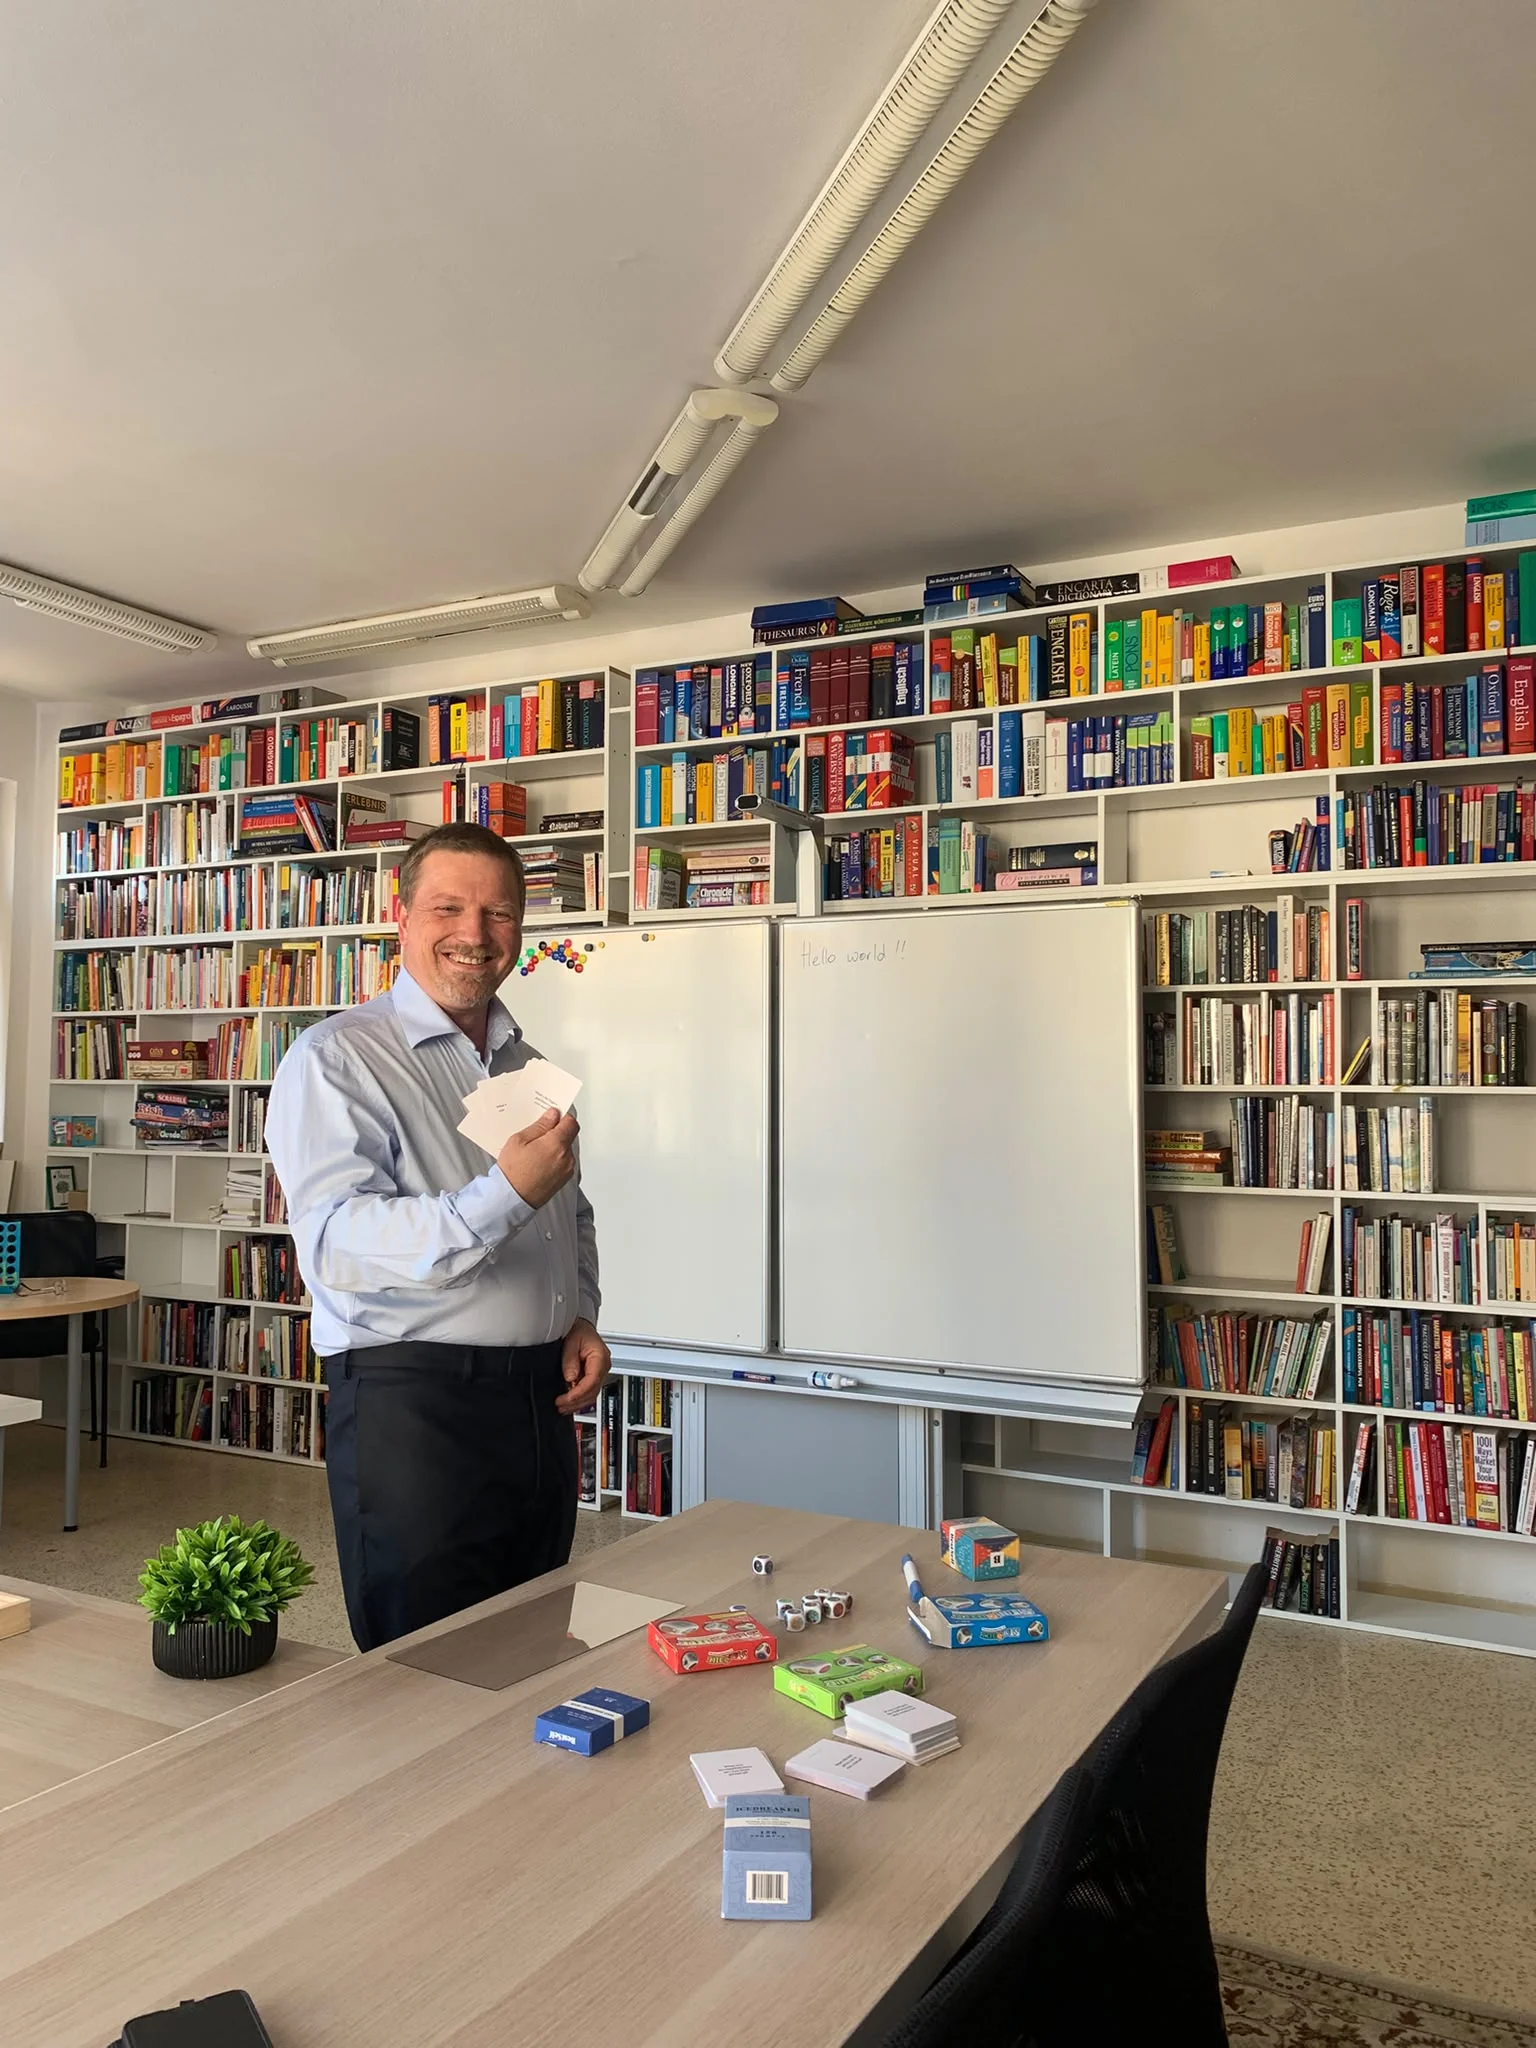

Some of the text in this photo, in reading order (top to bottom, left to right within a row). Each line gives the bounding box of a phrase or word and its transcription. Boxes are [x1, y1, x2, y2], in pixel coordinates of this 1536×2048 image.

[1057, 579, 1113, 594] ENCARTA
[1308, 594, 1324, 603] EURO
[1473, 576, 1482, 604] ENGLISH
[1368, 584, 1377, 628] LONGMAN
[1379, 583, 1399, 625] Roget's
[760, 625, 816, 641] THESAURUS
[1266, 615, 1275, 649] DIZIONARIO
[1050, 628, 1066, 685] ENGLISH
[1110, 652, 1119, 679] LATEIN
[1124, 635, 1139, 673] PONS
[729, 664, 737, 708] LONGMAN
[745, 667, 754, 704] OXFORD
[794, 667, 807, 711] French
[895, 666, 908, 706] Englisch
[962, 661, 970, 687] slovník
[226, 701, 254, 712] LAROUSSE
[779, 685, 788, 720] FRENCH
[914, 684, 922, 710] Englisch
[1487, 673, 1501, 714] Oxford
[1509, 679, 1529, 732] English
[582, 699, 590, 745] CAMBRIDGE
[1381, 706, 1389, 747] CHAMBERS
[1403, 682, 1415, 742] EURO SLOVNÍK
[1419, 701, 1429, 749] Concise English
[1447, 695, 1455, 736] THESAURUS
[1455, 694, 1463, 739] DICTIONARY
[1332, 712, 1340, 750] Ekonomika
[1355, 716, 1363, 748] Technika
[266, 735, 274, 772] SPAGNOLO
[811, 757, 821, 809] CAMBRIDGE
[829, 743, 838, 804] WEBSTER'S
[345, 793, 387, 811] ERLEBNIS
[480, 787, 489, 810] Anglais
[716, 764, 726, 821] ENGLISCH
[848, 802, 863, 810] LEDA
[1319, 798, 1327, 816] Oxford
[853, 838, 861, 865] Oxford
[911, 838, 919, 879] VISUAL
[699, 886, 733, 899] Chronicle
[1019, 878, 1068, 887] DICTIONARY
[801, 940, 837, 969] Hello
[847, 943, 887, 963] world
[136, 1102, 164, 1117] Risk
[156, 1092, 188, 1105] SCRABBLE
[1442, 1251, 1451, 1294] JACK LONDON
[1433, 1319, 1442, 1377] MARKETING YOURSELF
[1443, 1334, 1453, 1361] TOP DOG
[1476, 1436, 1492, 1448] 1001
[1476, 1447, 1493, 1457] Ways
[1268, 1455, 1276, 1489] BITTERSWEET
[1474, 1456, 1496, 1467] Market
[1476, 1472, 1495, 1483] Books
[1478, 1464, 1492, 1474] Your
[1481, 1498, 1494, 1508] John
[1270, 1545, 1283, 1580] GERRITSEN
[547, 1729, 577, 1746] BestSelf
[735, 1805, 801, 1814] ICEBREAKER
